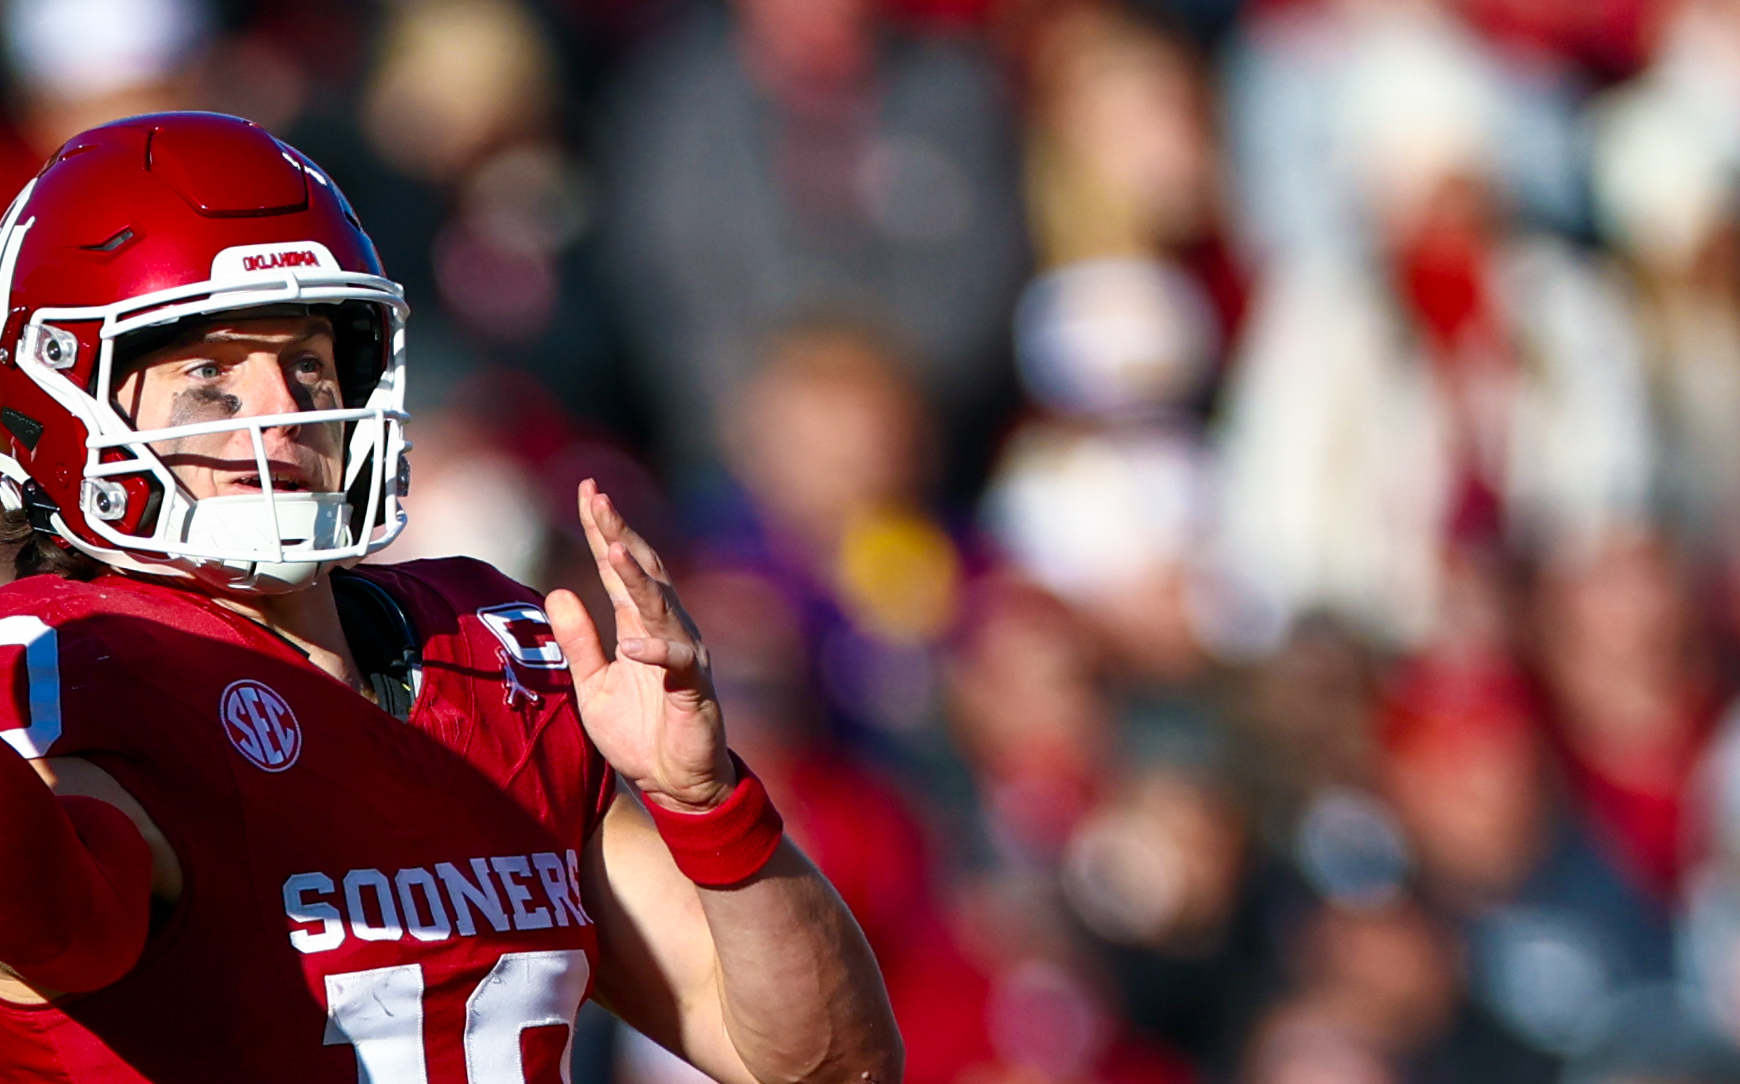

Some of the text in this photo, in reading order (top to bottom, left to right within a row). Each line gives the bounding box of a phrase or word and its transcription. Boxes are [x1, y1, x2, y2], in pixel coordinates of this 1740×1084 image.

[242, 250, 321, 272] OKLAHOMA
[482, 606, 565, 663] C
[226, 686, 296, 766] SEC
